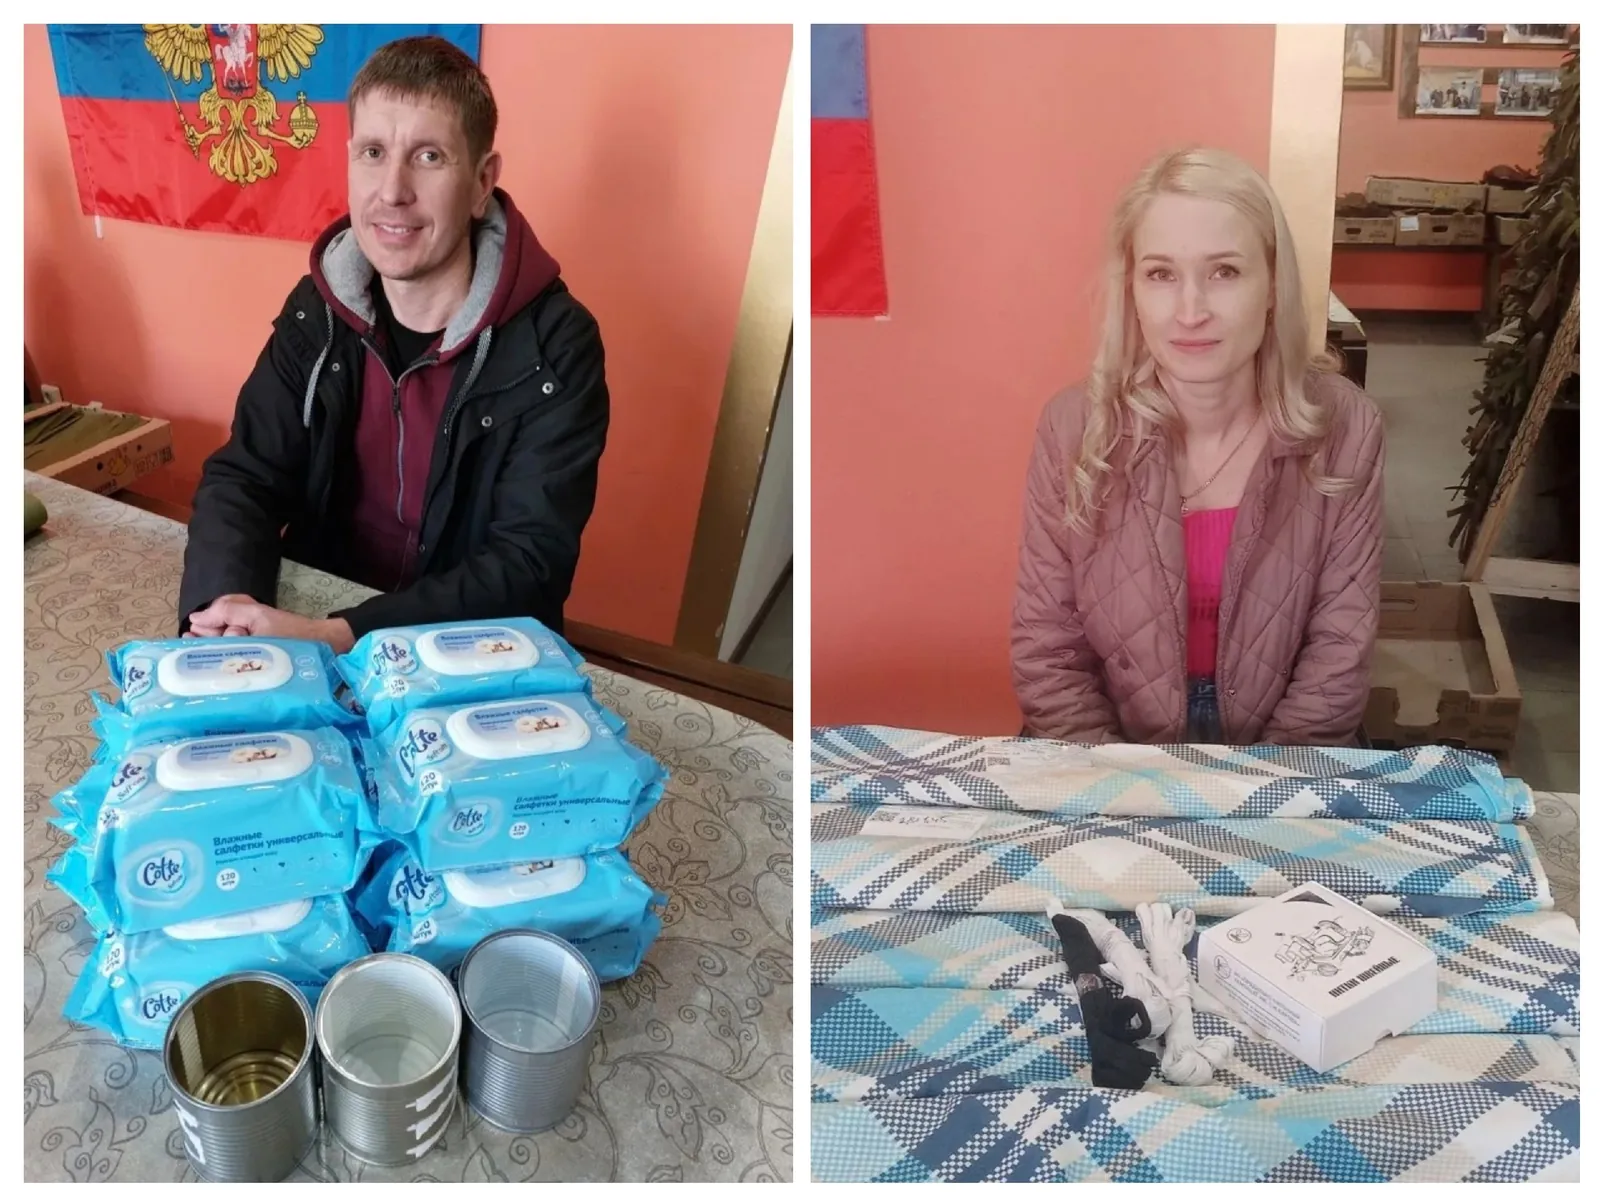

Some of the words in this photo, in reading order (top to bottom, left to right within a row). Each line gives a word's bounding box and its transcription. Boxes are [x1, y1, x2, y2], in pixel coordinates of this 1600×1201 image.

[420, 772, 436, 786] 120
[514, 799, 557, 811] салфетки
[559, 796, 631, 807] универсальные
[452, 808, 483, 832] Cotte
[512, 825, 527, 833] 120
[213, 831, 263, 847] Влажные
[214, 840, 264, 856] салфетки
[266, 830, 344, 849] универсальные
[143, 856, 180, 887] Cotte
[220, 872, 236, 882] 120
[1328, 978, 1360, 998] НИТКИ
[143, 993, 178, 1019] Cotte
